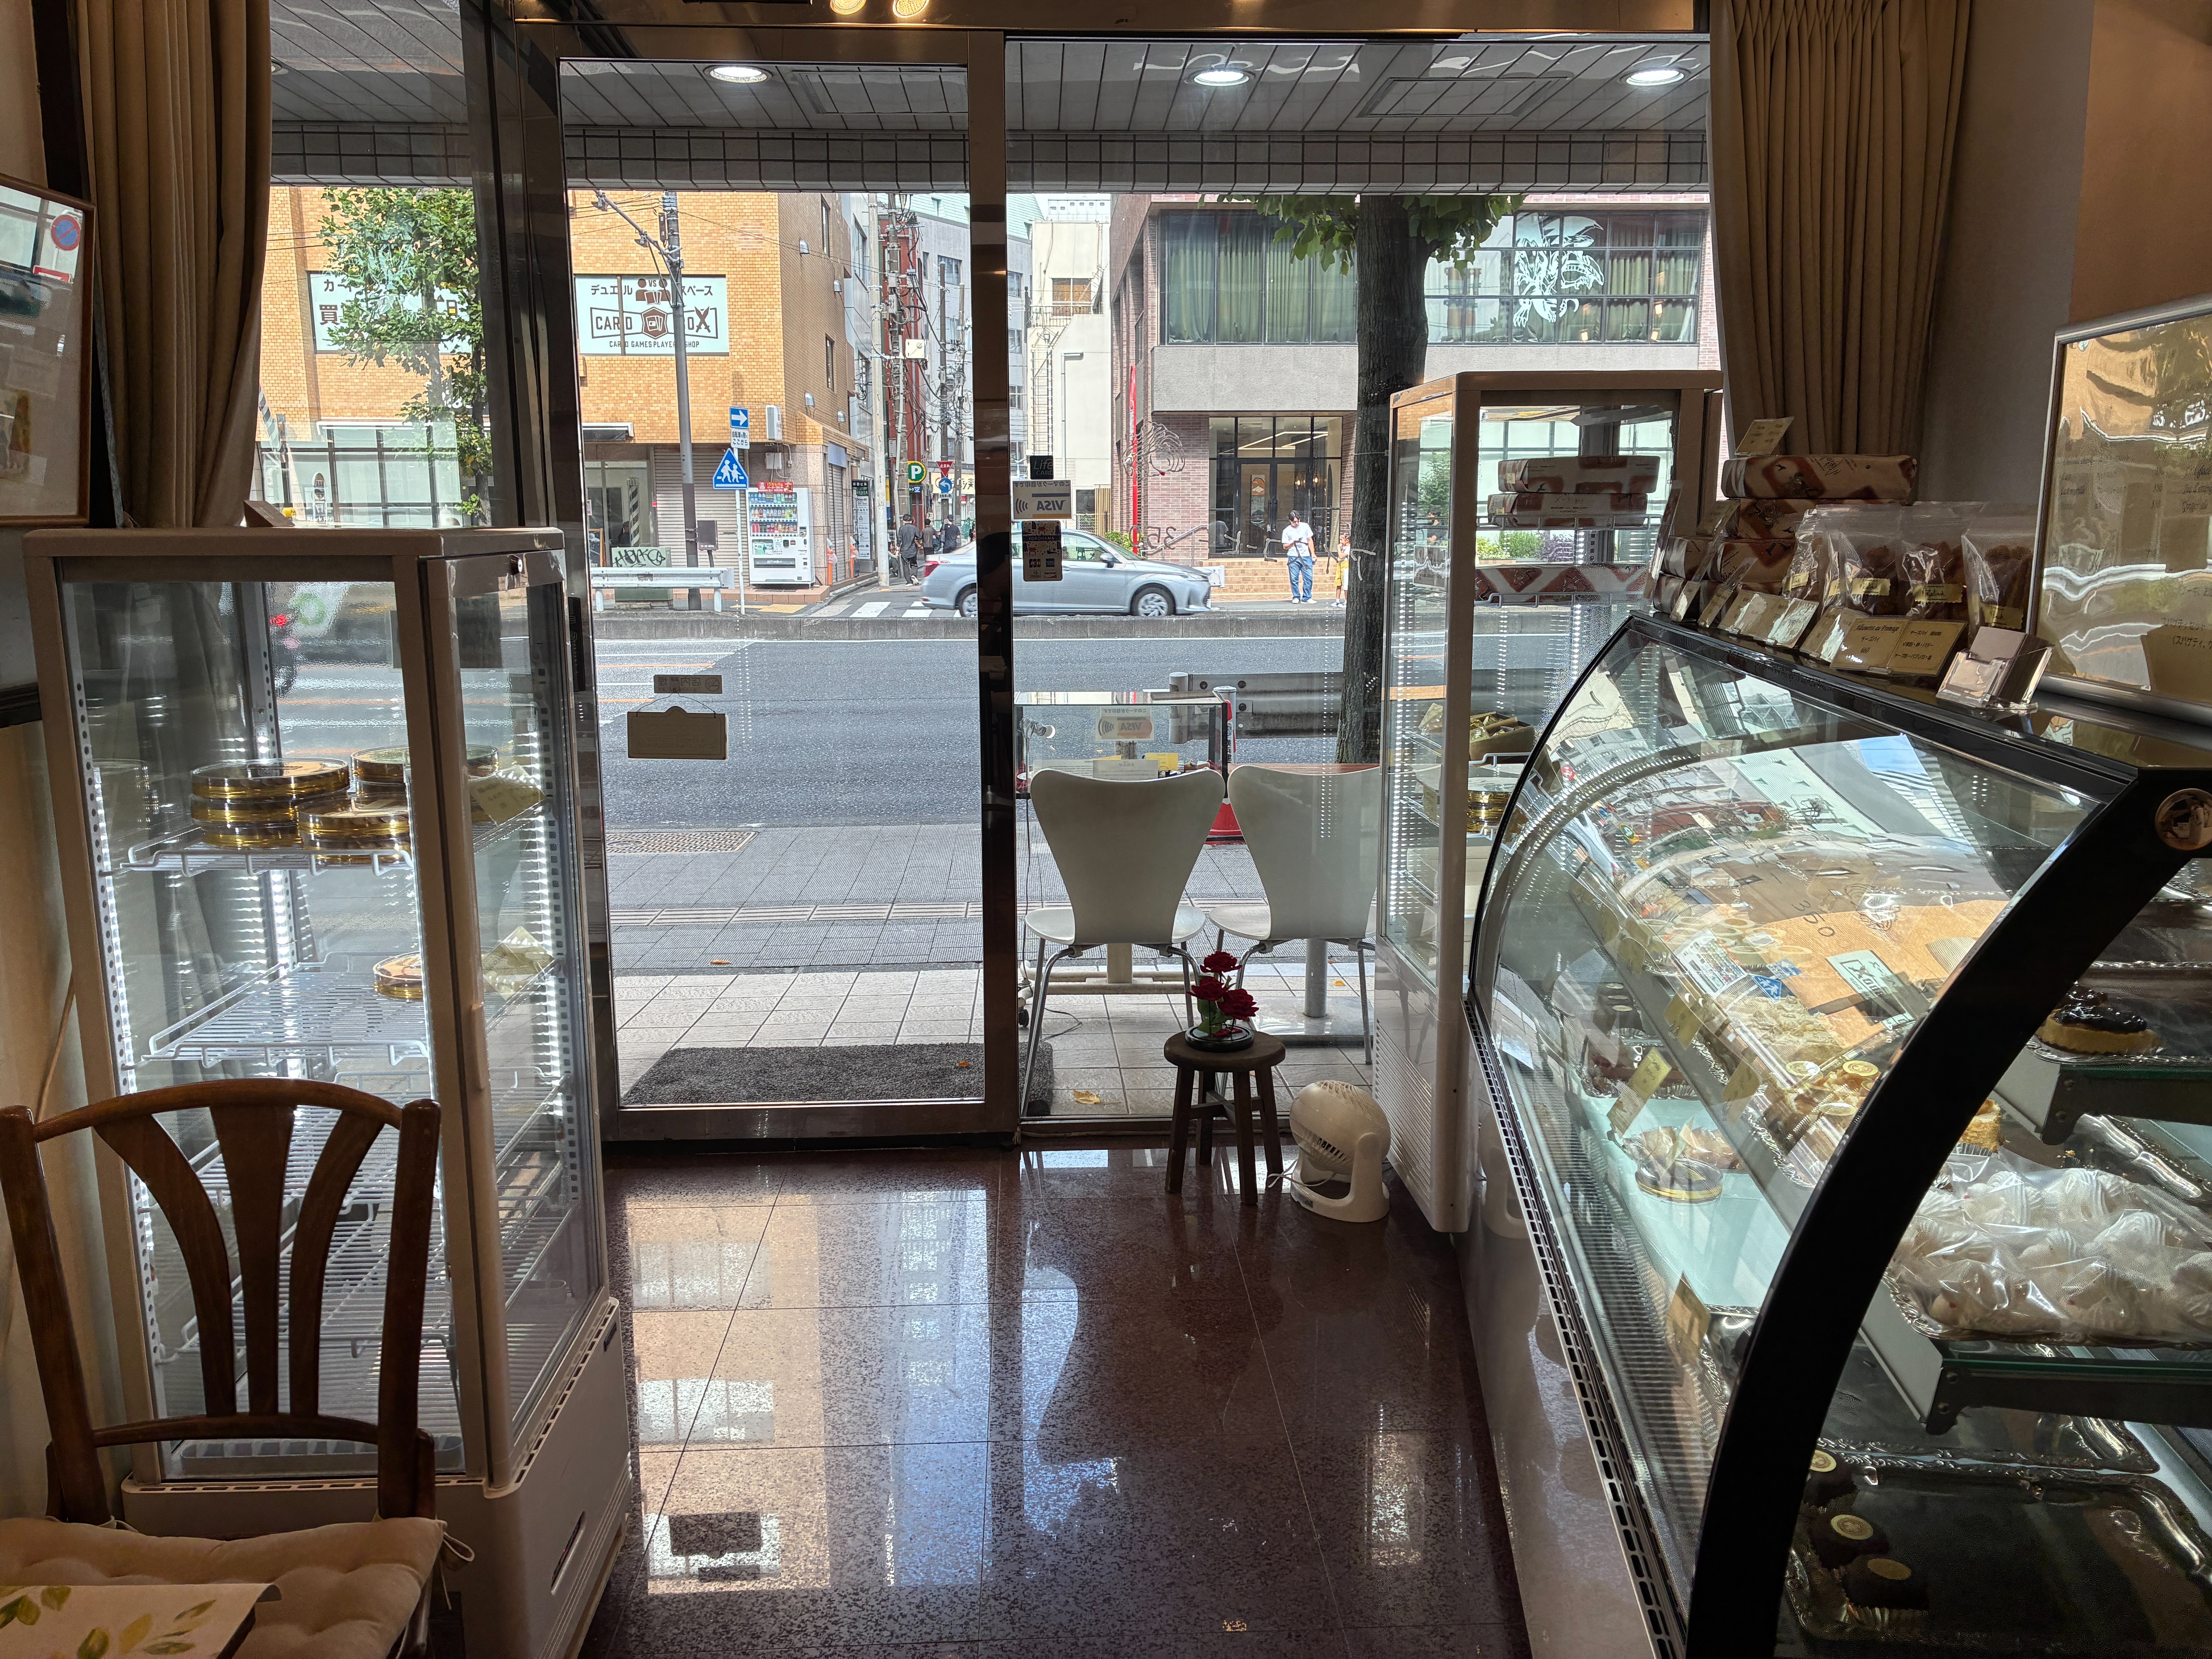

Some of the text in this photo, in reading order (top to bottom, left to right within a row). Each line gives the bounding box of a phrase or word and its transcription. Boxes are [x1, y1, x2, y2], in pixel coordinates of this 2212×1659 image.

[595, 306, 711, 333] CARD OX
[911, 465, 922, 479] P
